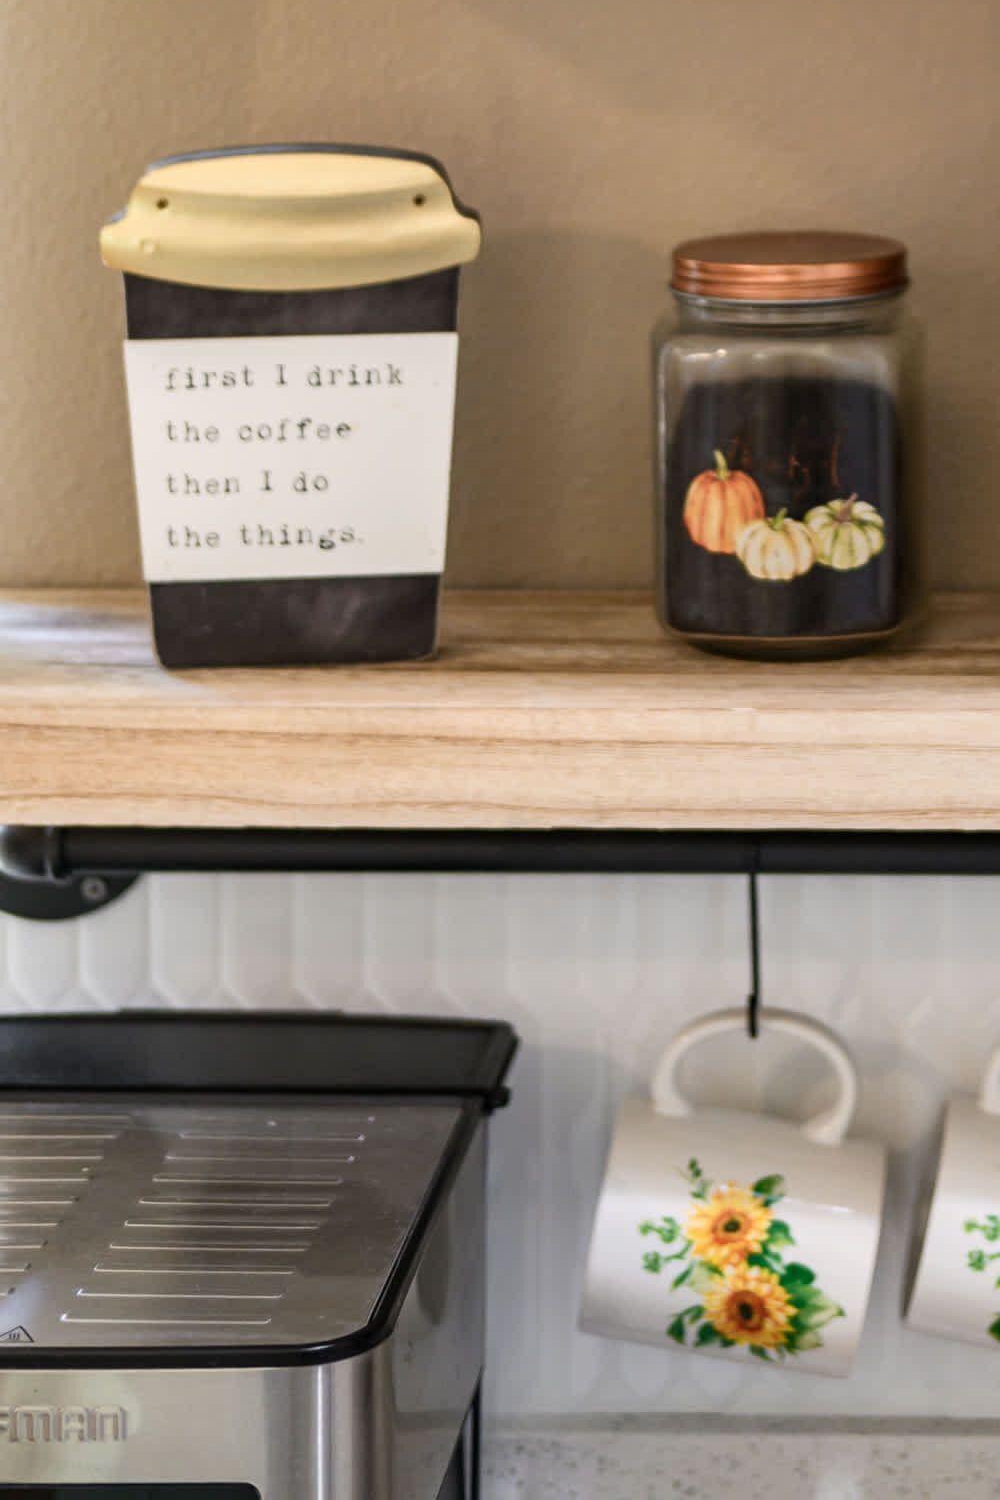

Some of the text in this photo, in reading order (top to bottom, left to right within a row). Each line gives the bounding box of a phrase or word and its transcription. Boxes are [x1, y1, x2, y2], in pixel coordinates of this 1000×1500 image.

[165, 363, 404, 391] first I drink
[166, 417, 353, 443] the coffee
[166, 469, 330, 496] then I do
[166, 524, 221, 548] the
